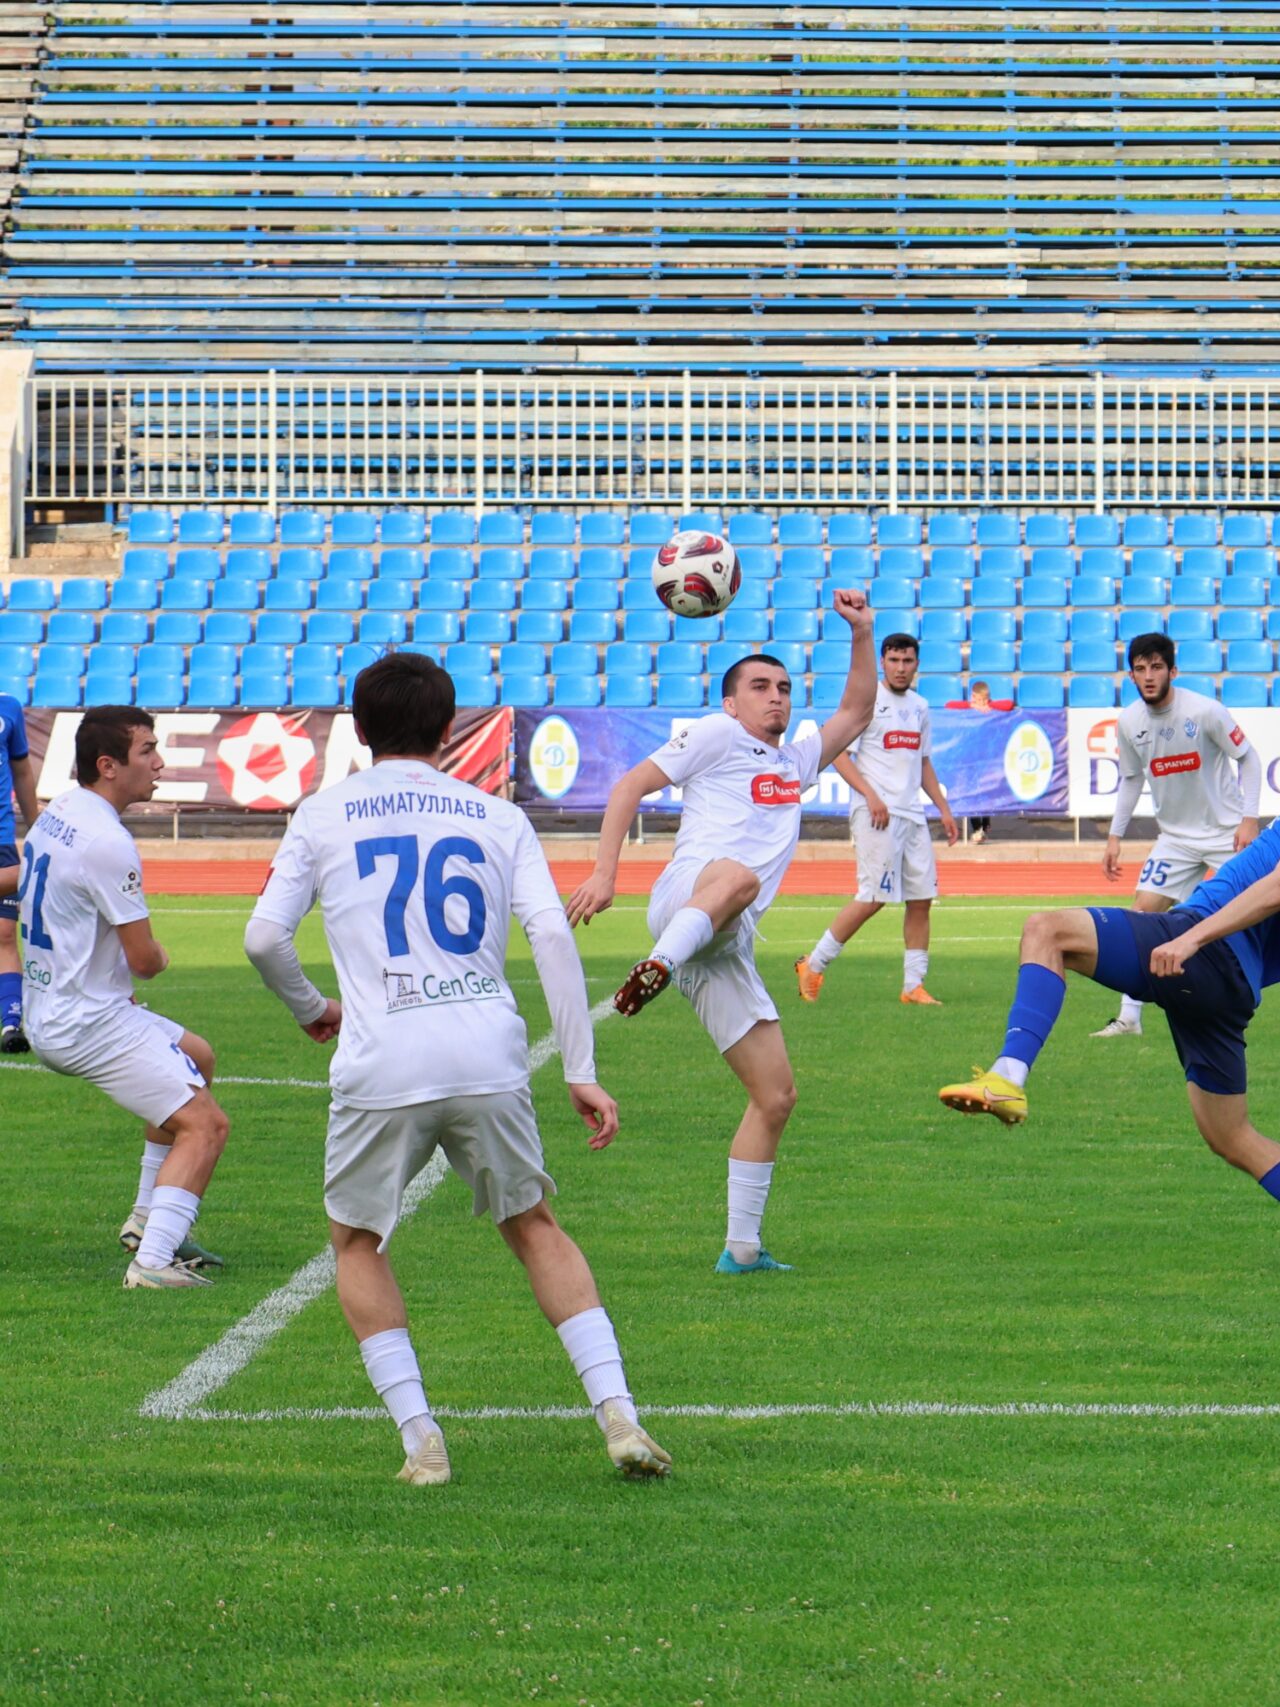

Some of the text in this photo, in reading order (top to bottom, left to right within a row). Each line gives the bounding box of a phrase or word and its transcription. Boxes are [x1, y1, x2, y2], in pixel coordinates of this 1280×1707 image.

[1164, 758, 1195, 769] МАГНИТ
[345, 791, 487, 822] РИКМАТУЛЛАЕВ
[1140, 859, 1171, 886] 95
[354, 833, 487, 957] 76
[387, 996, 422, 1011] ДАГНЕФТЬ
